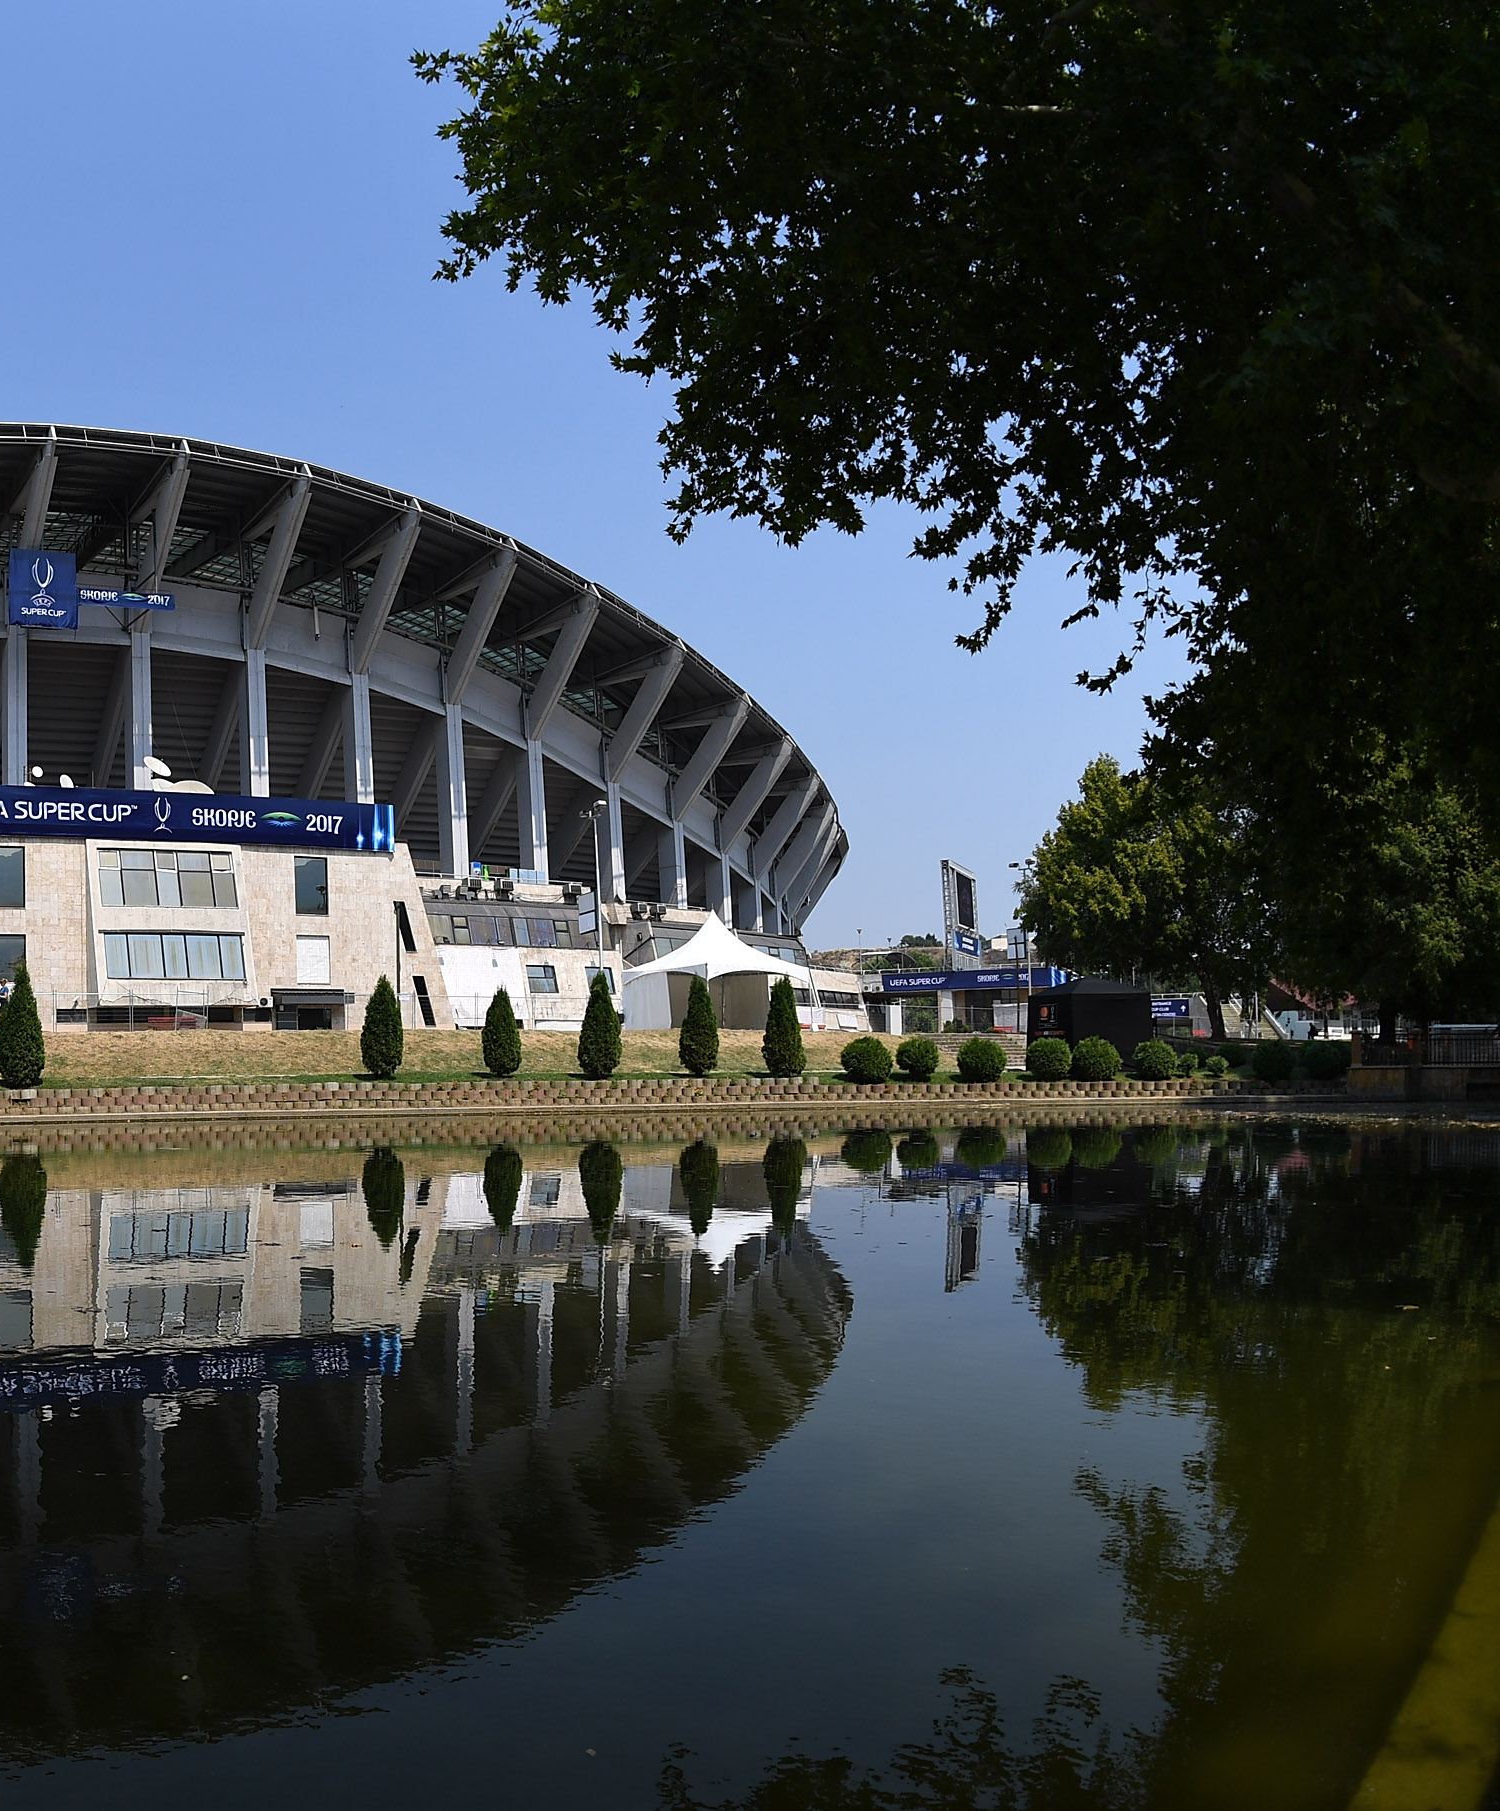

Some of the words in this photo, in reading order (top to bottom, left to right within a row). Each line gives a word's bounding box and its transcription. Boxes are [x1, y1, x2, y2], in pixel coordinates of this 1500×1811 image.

[80, 589, 118, 602] SKOPJE
[147, 594, 170, 607] 2017
[21, 607, 47, 616] SUPER
[14, 801, 86, 821] SUPER
[192, 808, 257, 828] SKOPJE
[305, 814, 344, 835] 2017
[889, 978, 908, 987] UEFA
[908, 977, 931, 986] SUPER
[977, 975, 1000, 983] SKOPJE
